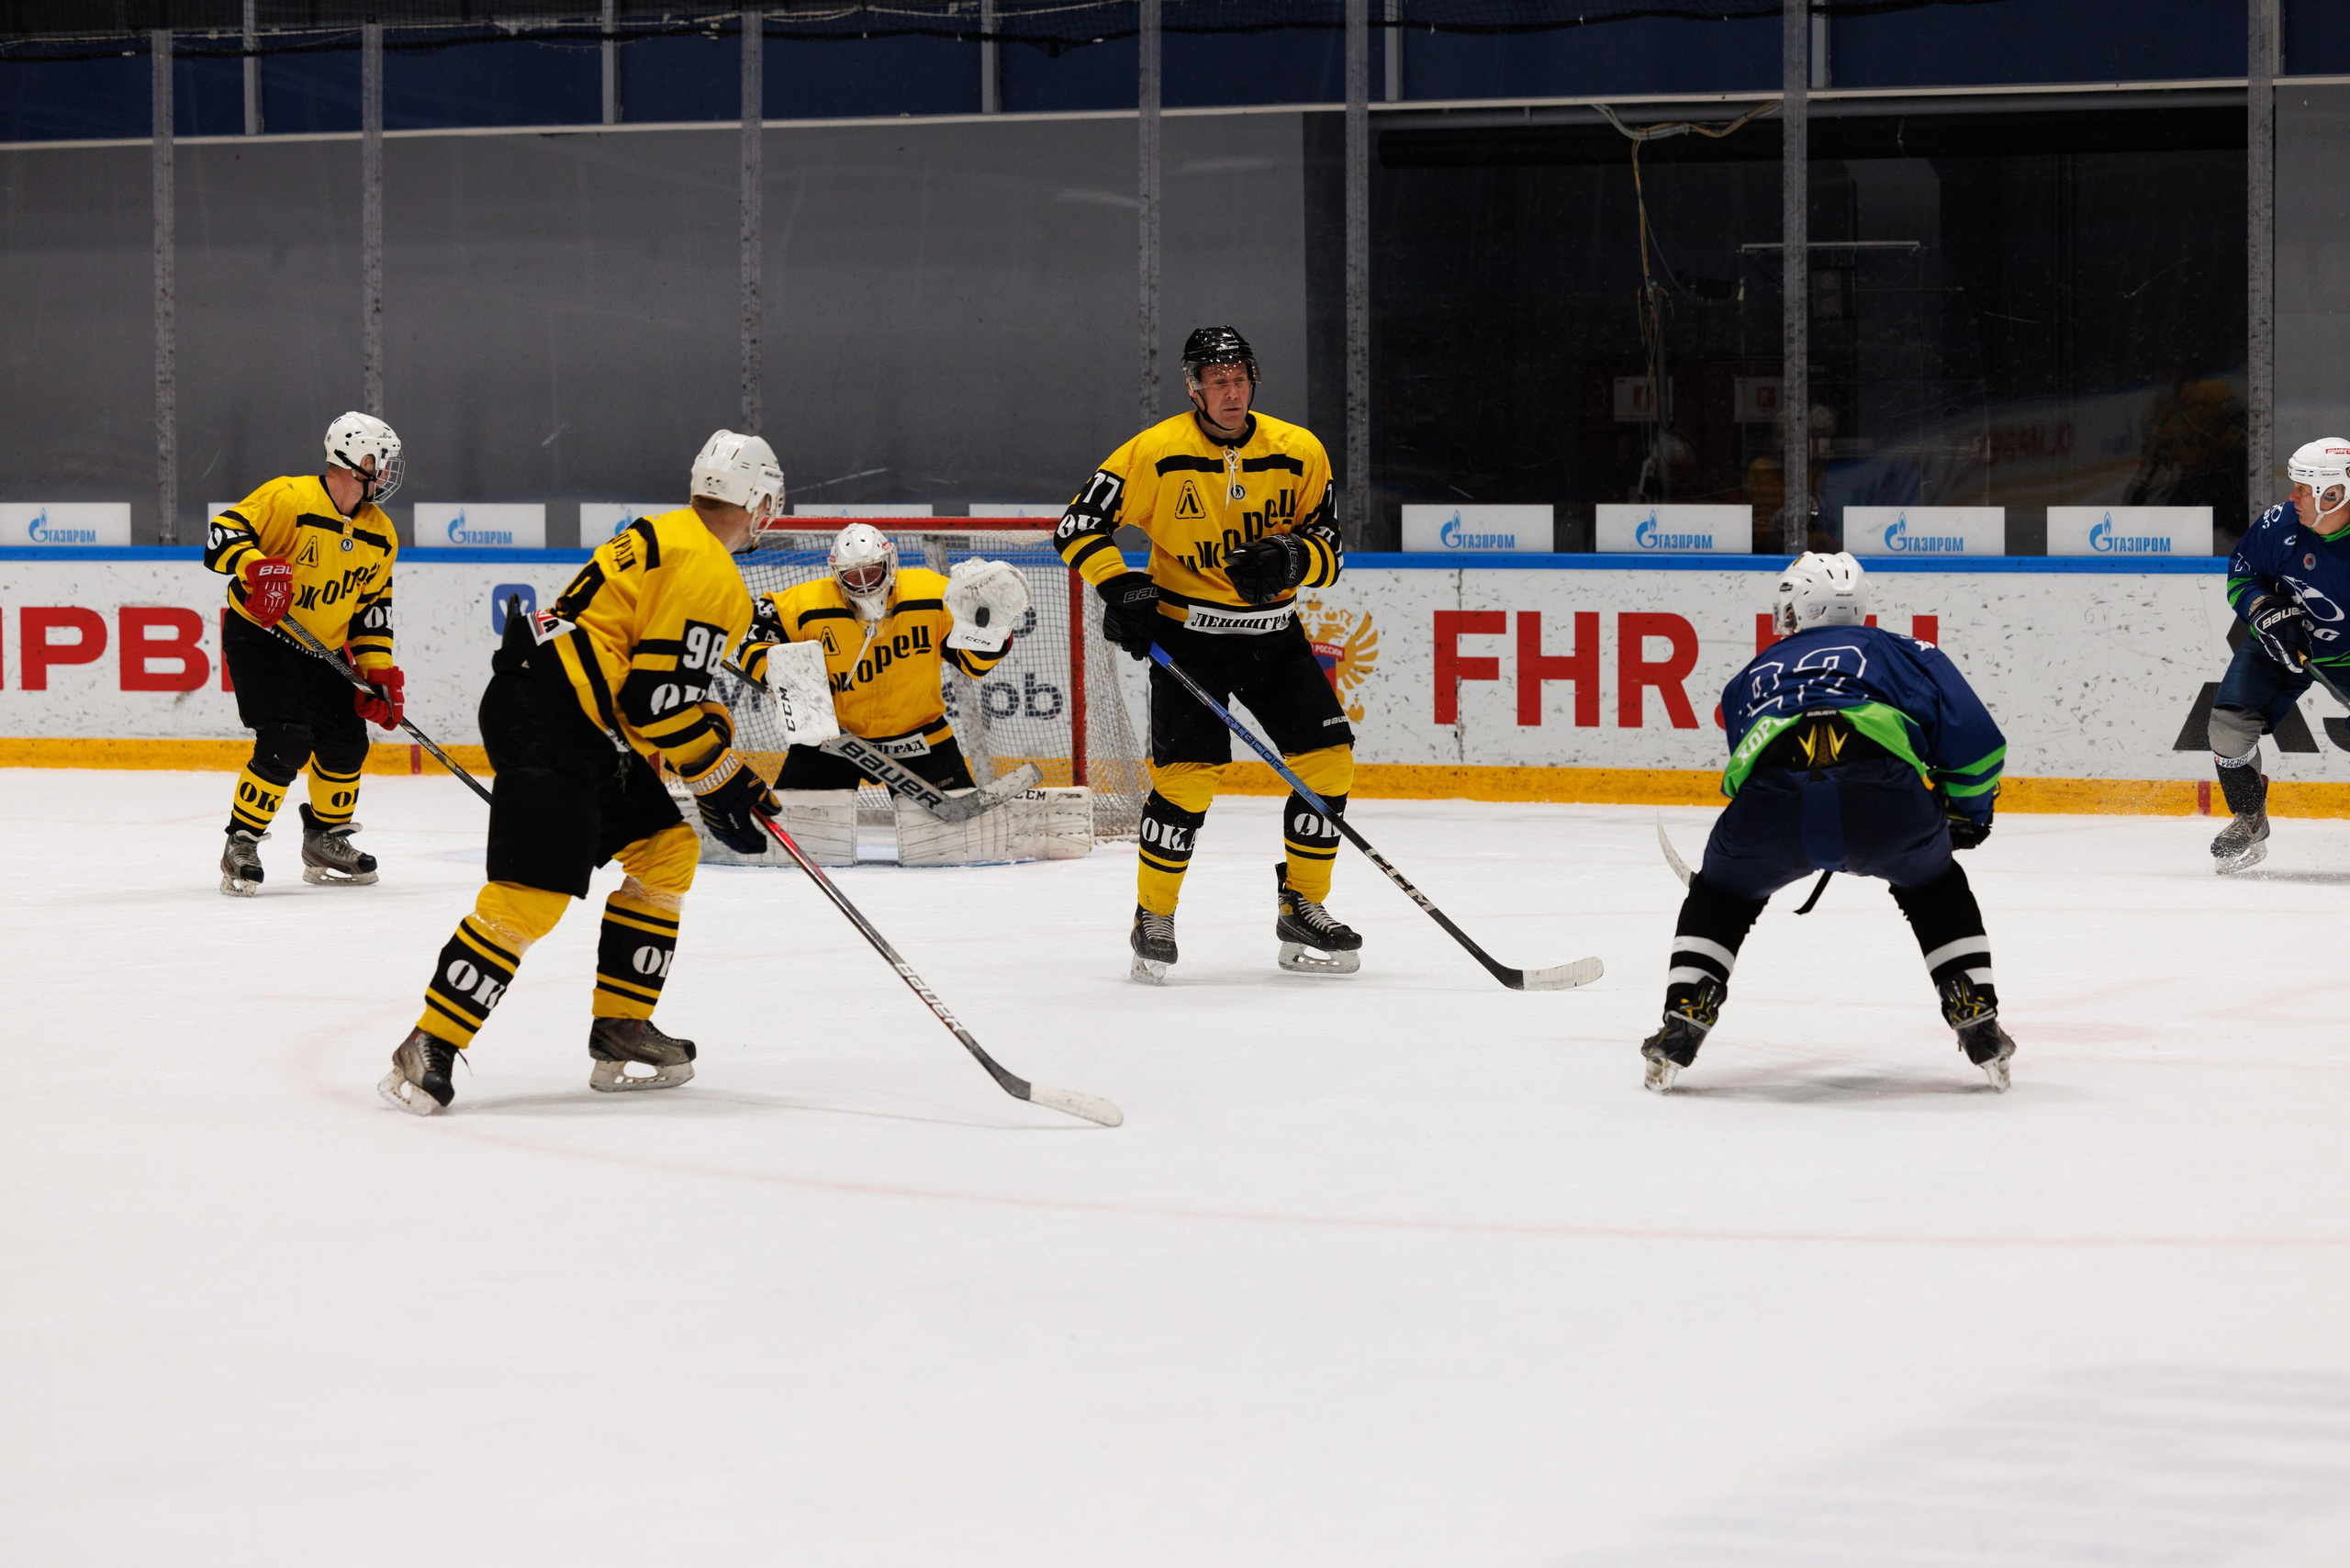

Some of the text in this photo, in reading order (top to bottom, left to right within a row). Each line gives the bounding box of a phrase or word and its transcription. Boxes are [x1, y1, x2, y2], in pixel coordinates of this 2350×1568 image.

[1083, 472, 1121, 511] 77
[49, 530, 96, 543] ГАЗПРОМ
[466, 531, 512, 544] ГАЗПРОМ
[1463, 534, 1516, 549] ГАЗПРОМ
[1659, 534, 1713, 549] ГАЗПРОМ
[1906, 537, 1964, 552] ГАЗПРОМ
[2111, 537, 2170, 552] ГАЗПРОМ
[965, 635, 991, 646] CCM
[682, 626, 728, 675] 98
[1315, 644, 1343, 657] РОССИИ
[778, 686, 796, 733] CCM
[839, 741, 944, 811] BAUER
[894, 962, 967, 1032] BAUER
